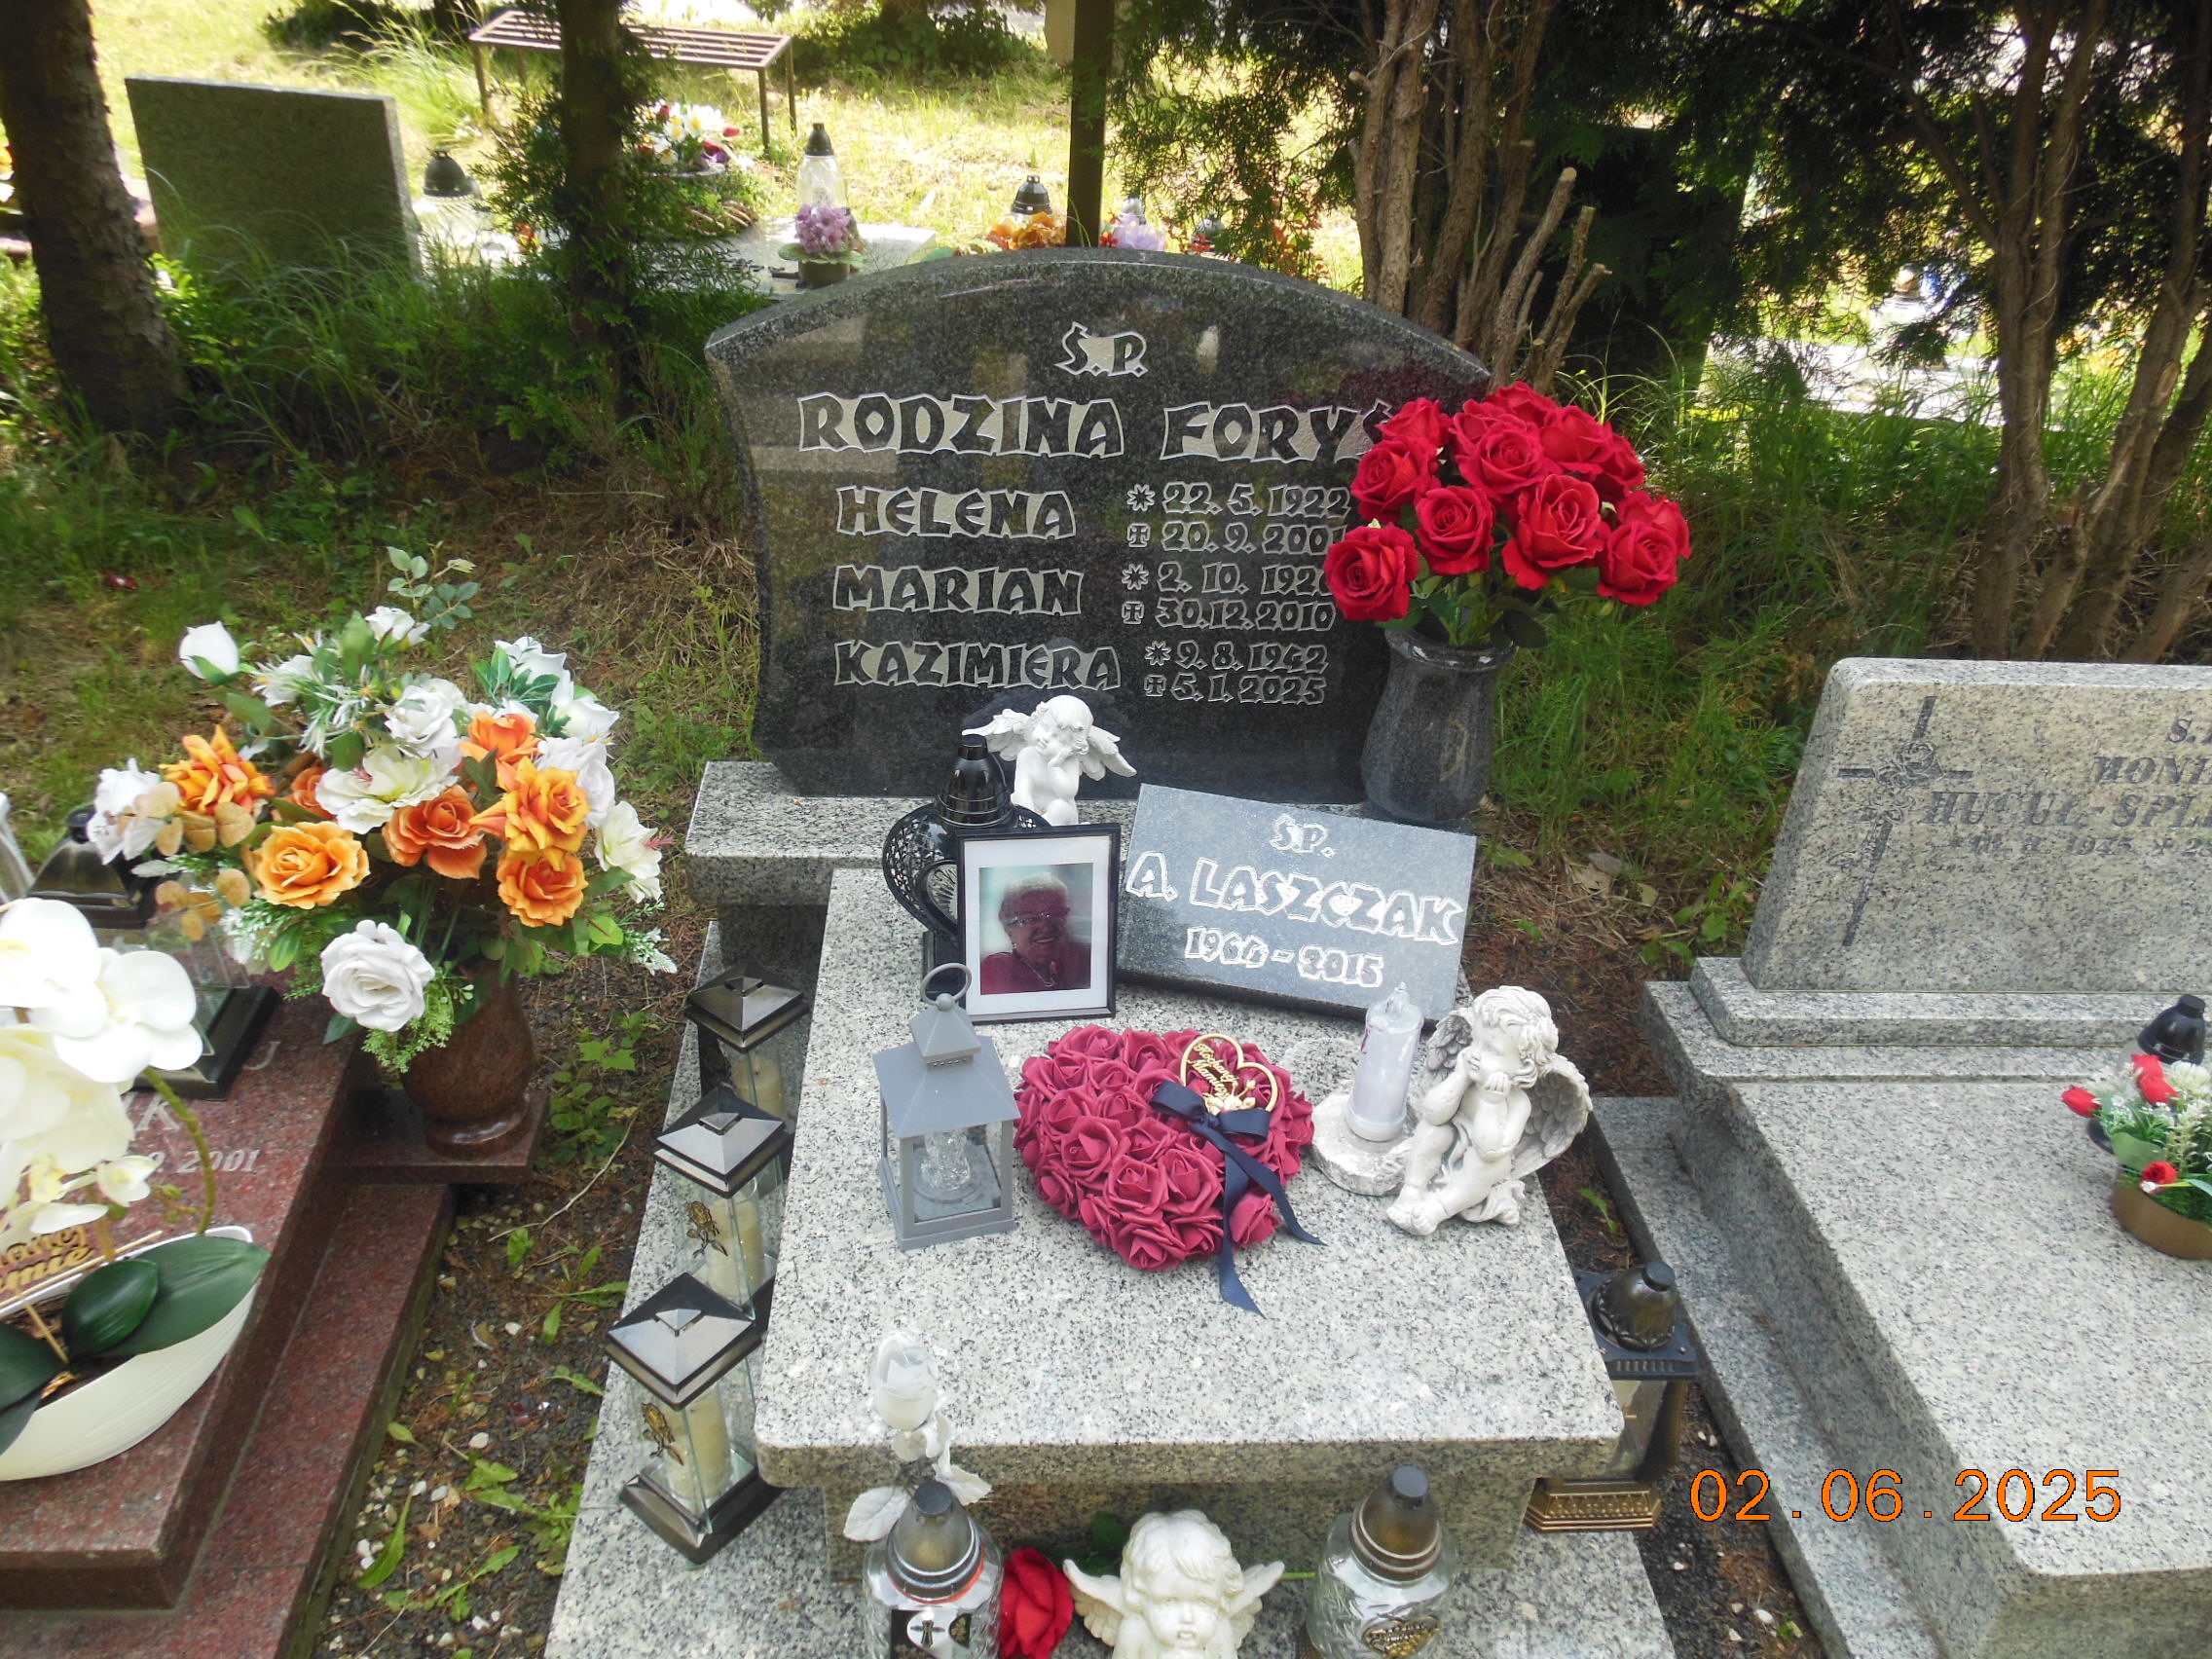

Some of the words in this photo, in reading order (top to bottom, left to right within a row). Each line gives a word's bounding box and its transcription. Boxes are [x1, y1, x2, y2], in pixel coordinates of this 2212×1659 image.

[1053, 320, 1149, 378] Ś.P.
[797, 391, 1124, 459] RODZINA
[836, 487, 1076, 539] HELENA
[1161, 481, 1223, 515] 22.
[1227, 483, 1263, 516] 5.
[1267, 484, 1351, 518] 1922
[1223, 522, 1256, 553] 9.
[833, 562, 1084, 615] MARIAN
[1157, 561, 1193, 593] 2.
[1201, 562, 1249, 594] 10.
[1261, 563, 1332, 596] 192
[833, 640, 1121, 690] KAZIMIERA
[1175, 640, 1207, 669] 9.
[1212, 642, 1243, 671] 8.
[1247, 642, 1329, 674] 1942
[1170, 672, 1203, 701] 5.
[1207, 673, 1234, 702] 1.
[1238, 675, 1327, 705] 2025
[1125, 851, 1179, 902] A.
